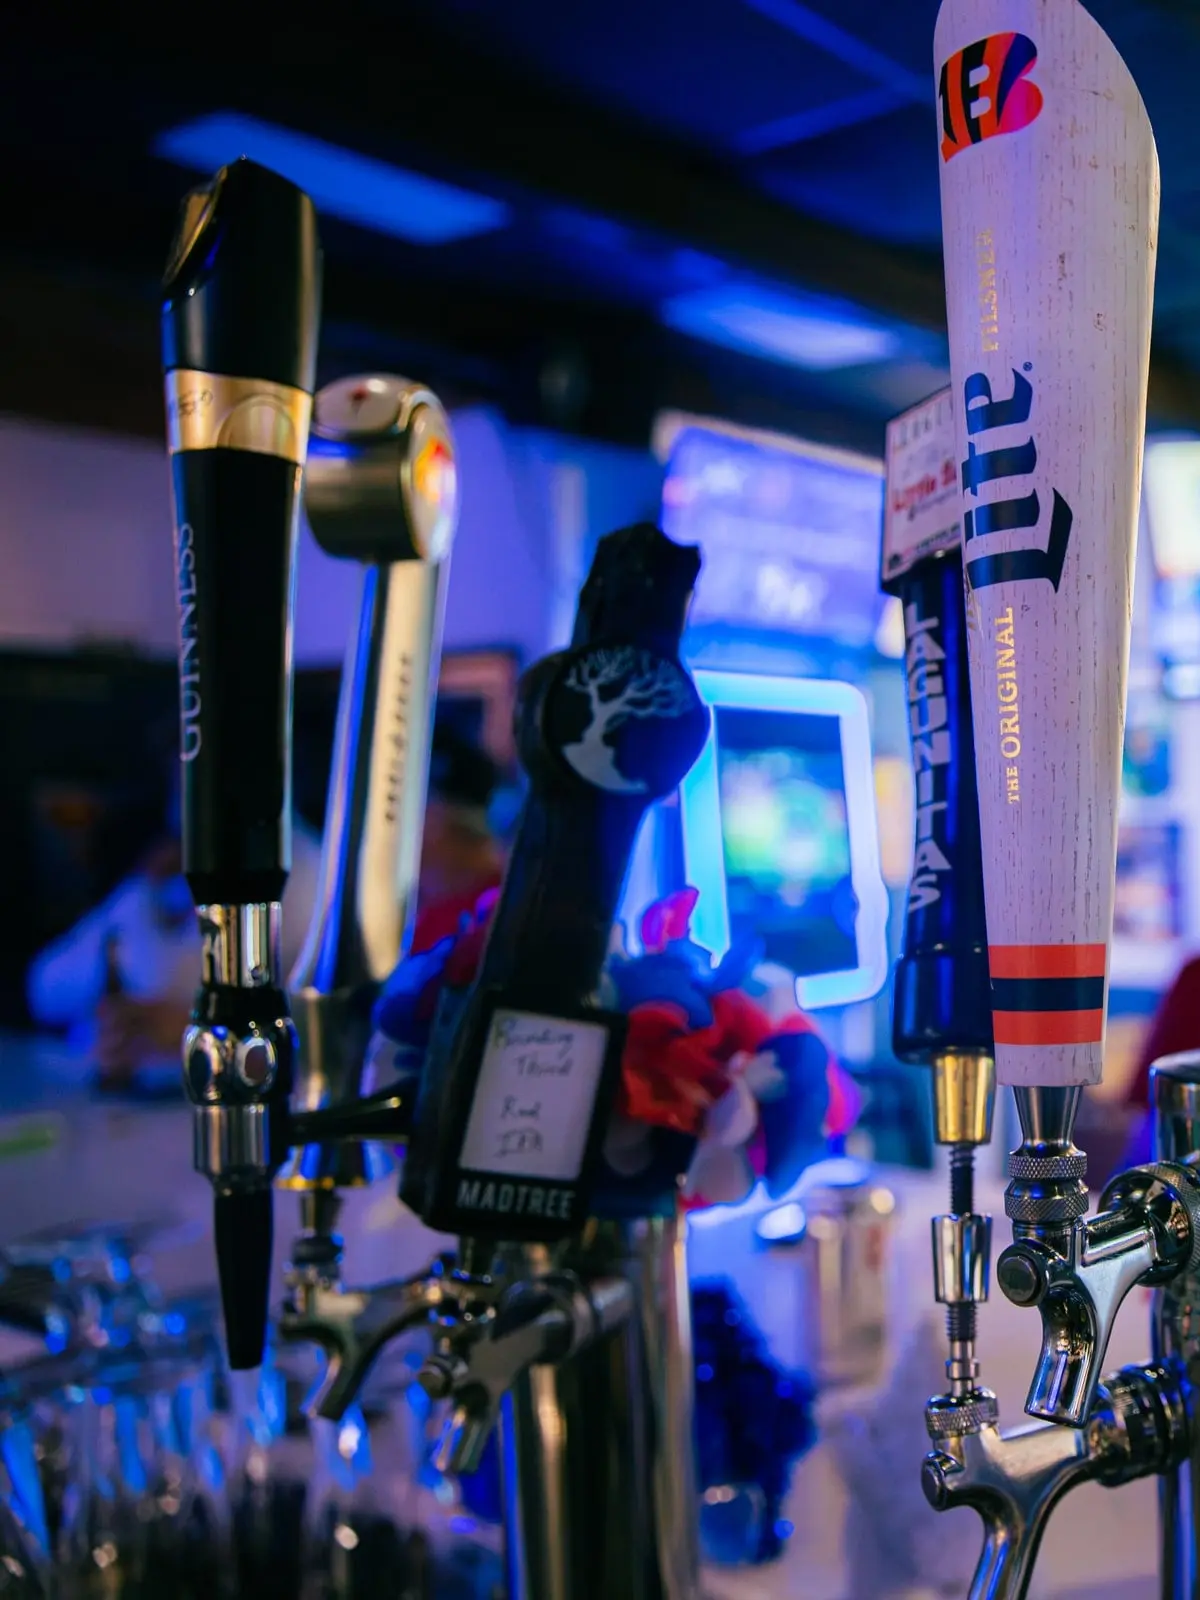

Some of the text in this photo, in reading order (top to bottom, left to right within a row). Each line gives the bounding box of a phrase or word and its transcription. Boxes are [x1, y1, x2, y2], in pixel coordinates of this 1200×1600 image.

[978, 229, 999, 352] PILSNER
[179, 522, 202, 762] GUINNESS
[994, 607, 1021, 805] THE ORIGINAL
[903, 602, 952, 913] LAGUNITAS
[456, 1179, 576, 1220] MADTREE
